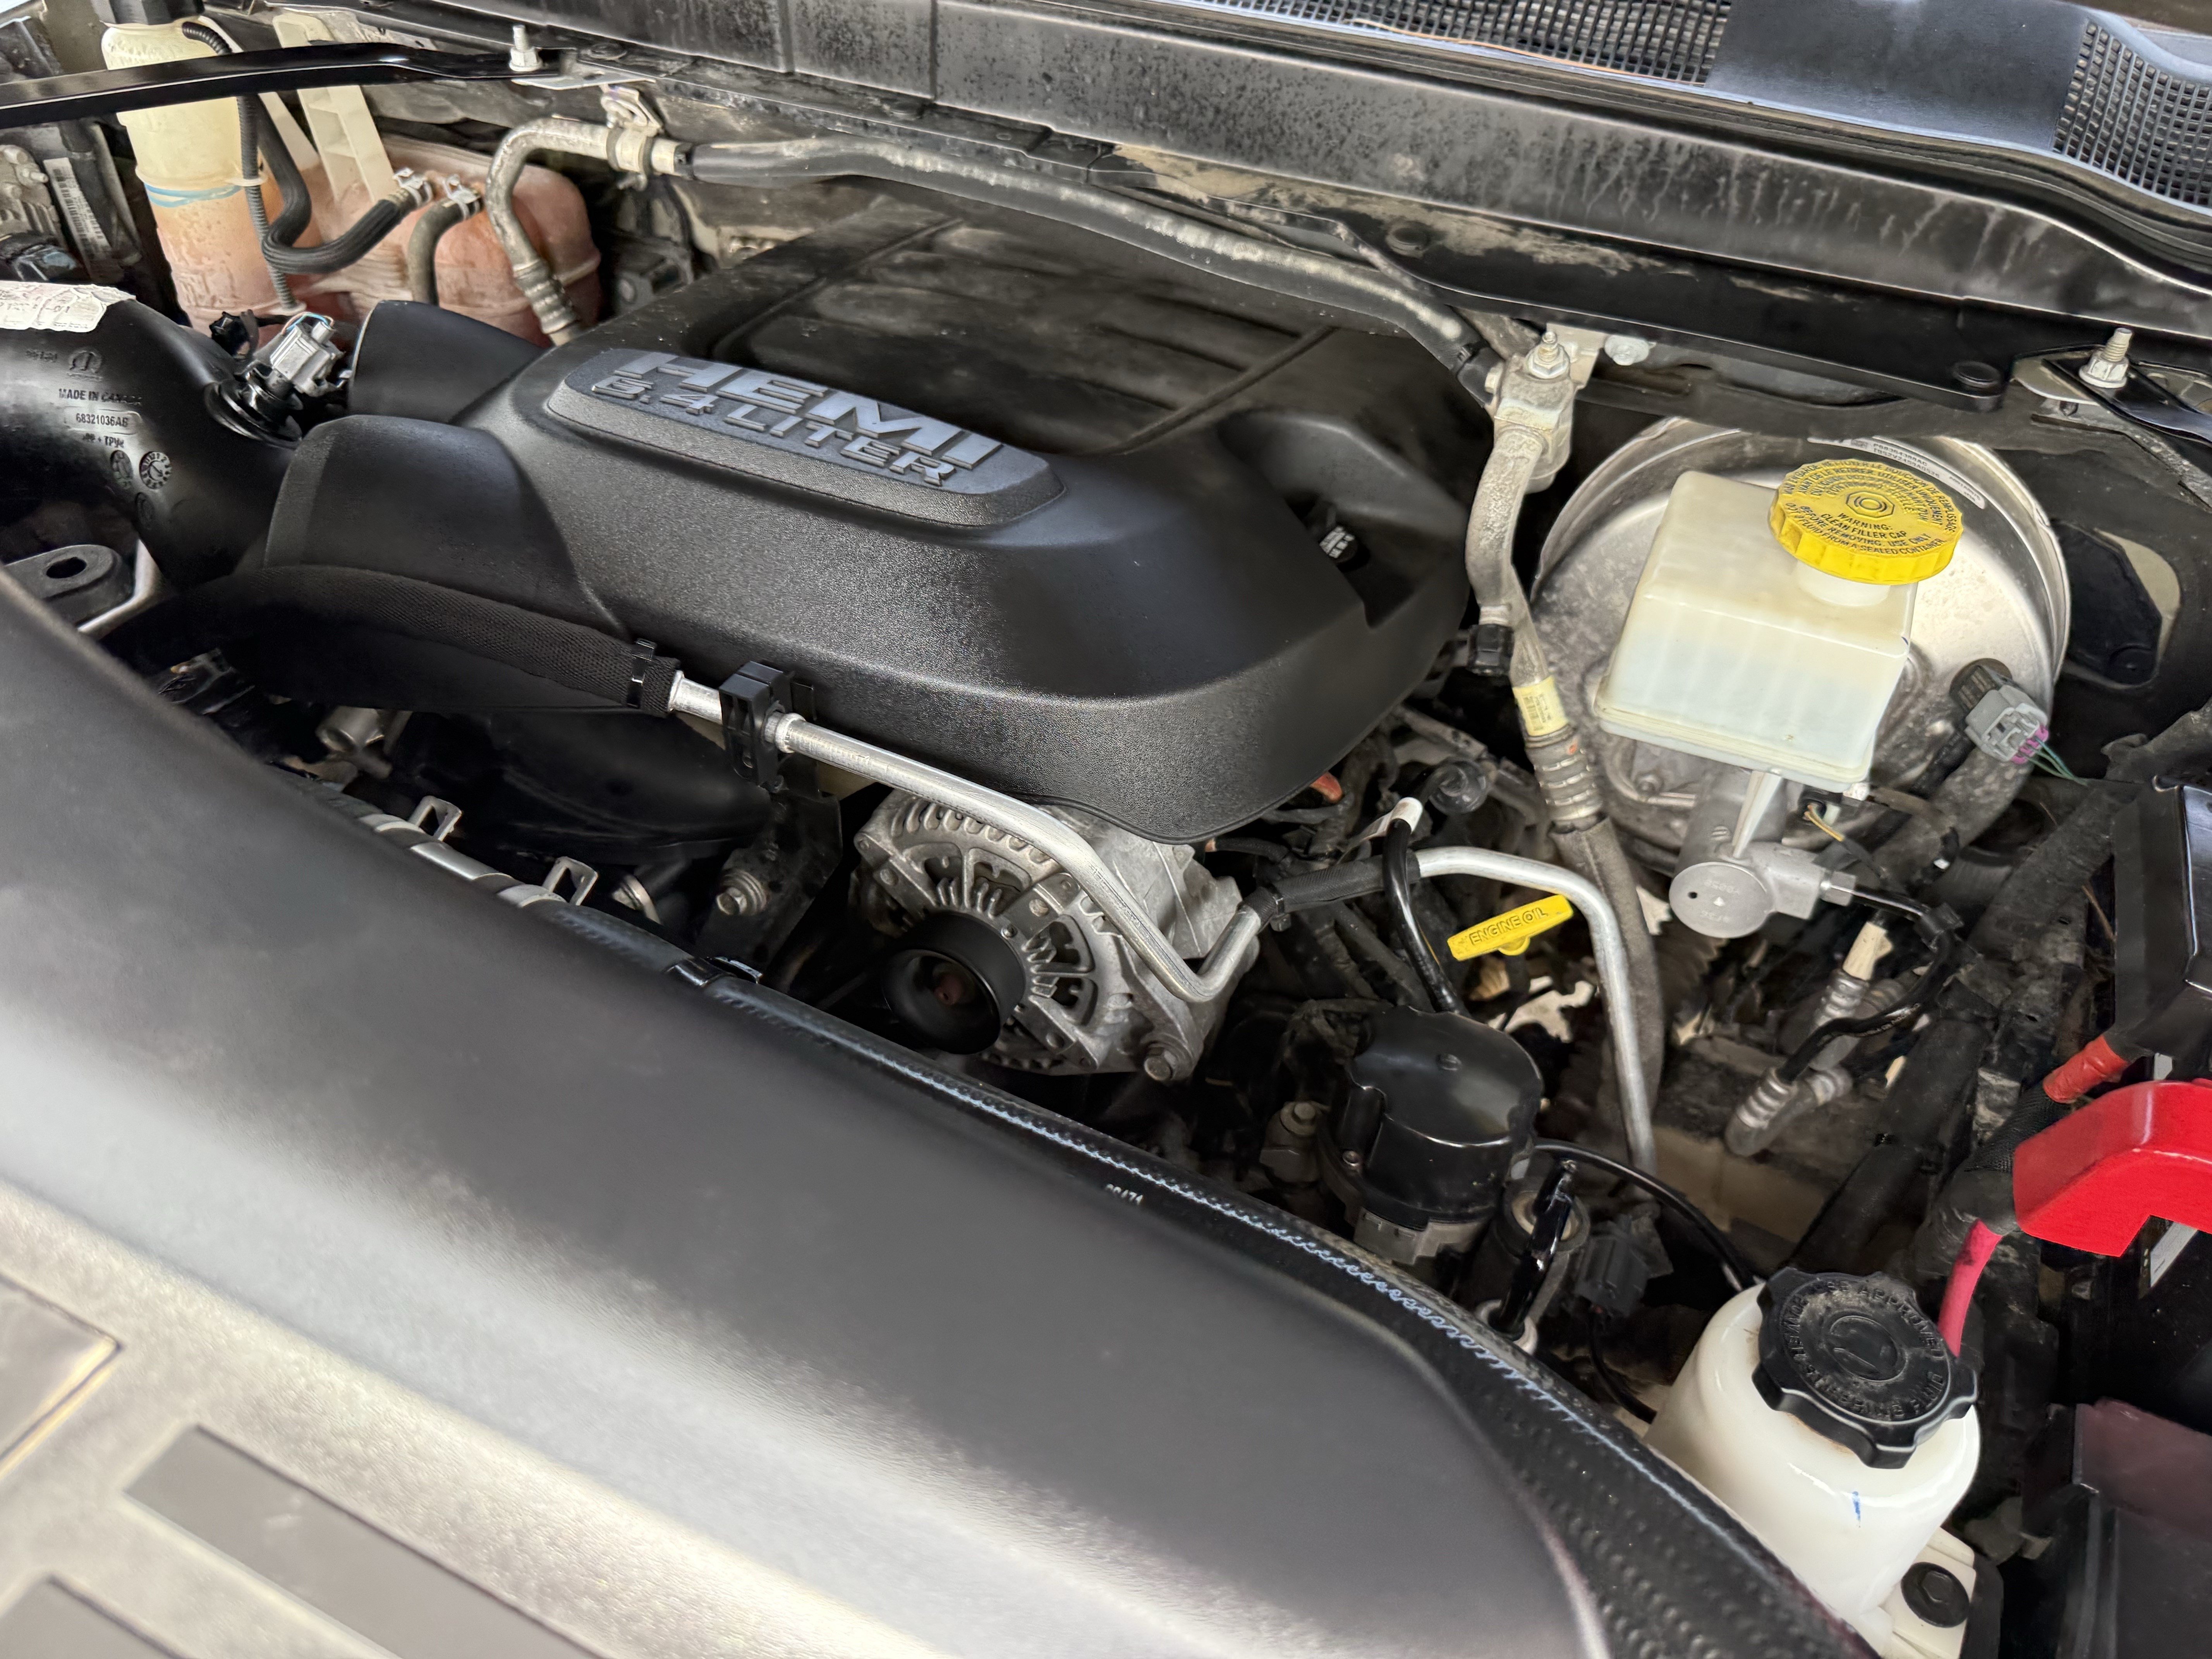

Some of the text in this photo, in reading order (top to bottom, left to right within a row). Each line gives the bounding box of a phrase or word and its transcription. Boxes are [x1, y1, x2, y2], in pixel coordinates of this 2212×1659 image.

[58, 388, 87, 400] MADE
[88, 390, 99, 401] IN
[614, 350, 1005, 470] HEMI
[591, 375, 956, 487] 6.4 LITER
[1927, 487, 1940, 495] DE
[1798, 519, 1823, 534] FLUID
[1821, 532, 1849, 546] FROM
[1860, 545, 1898, 555] SEALED
[1899, 538, 1946, 555] CONTAINER
[1800, 506, 1829, 528] BEFORE
[1908, 532, 1932, 545] ONLY
[1821, 513, 1907, 539] CLEAN FILLER CAP
[1469, 907, 1548, 946] ENGINE OIL
